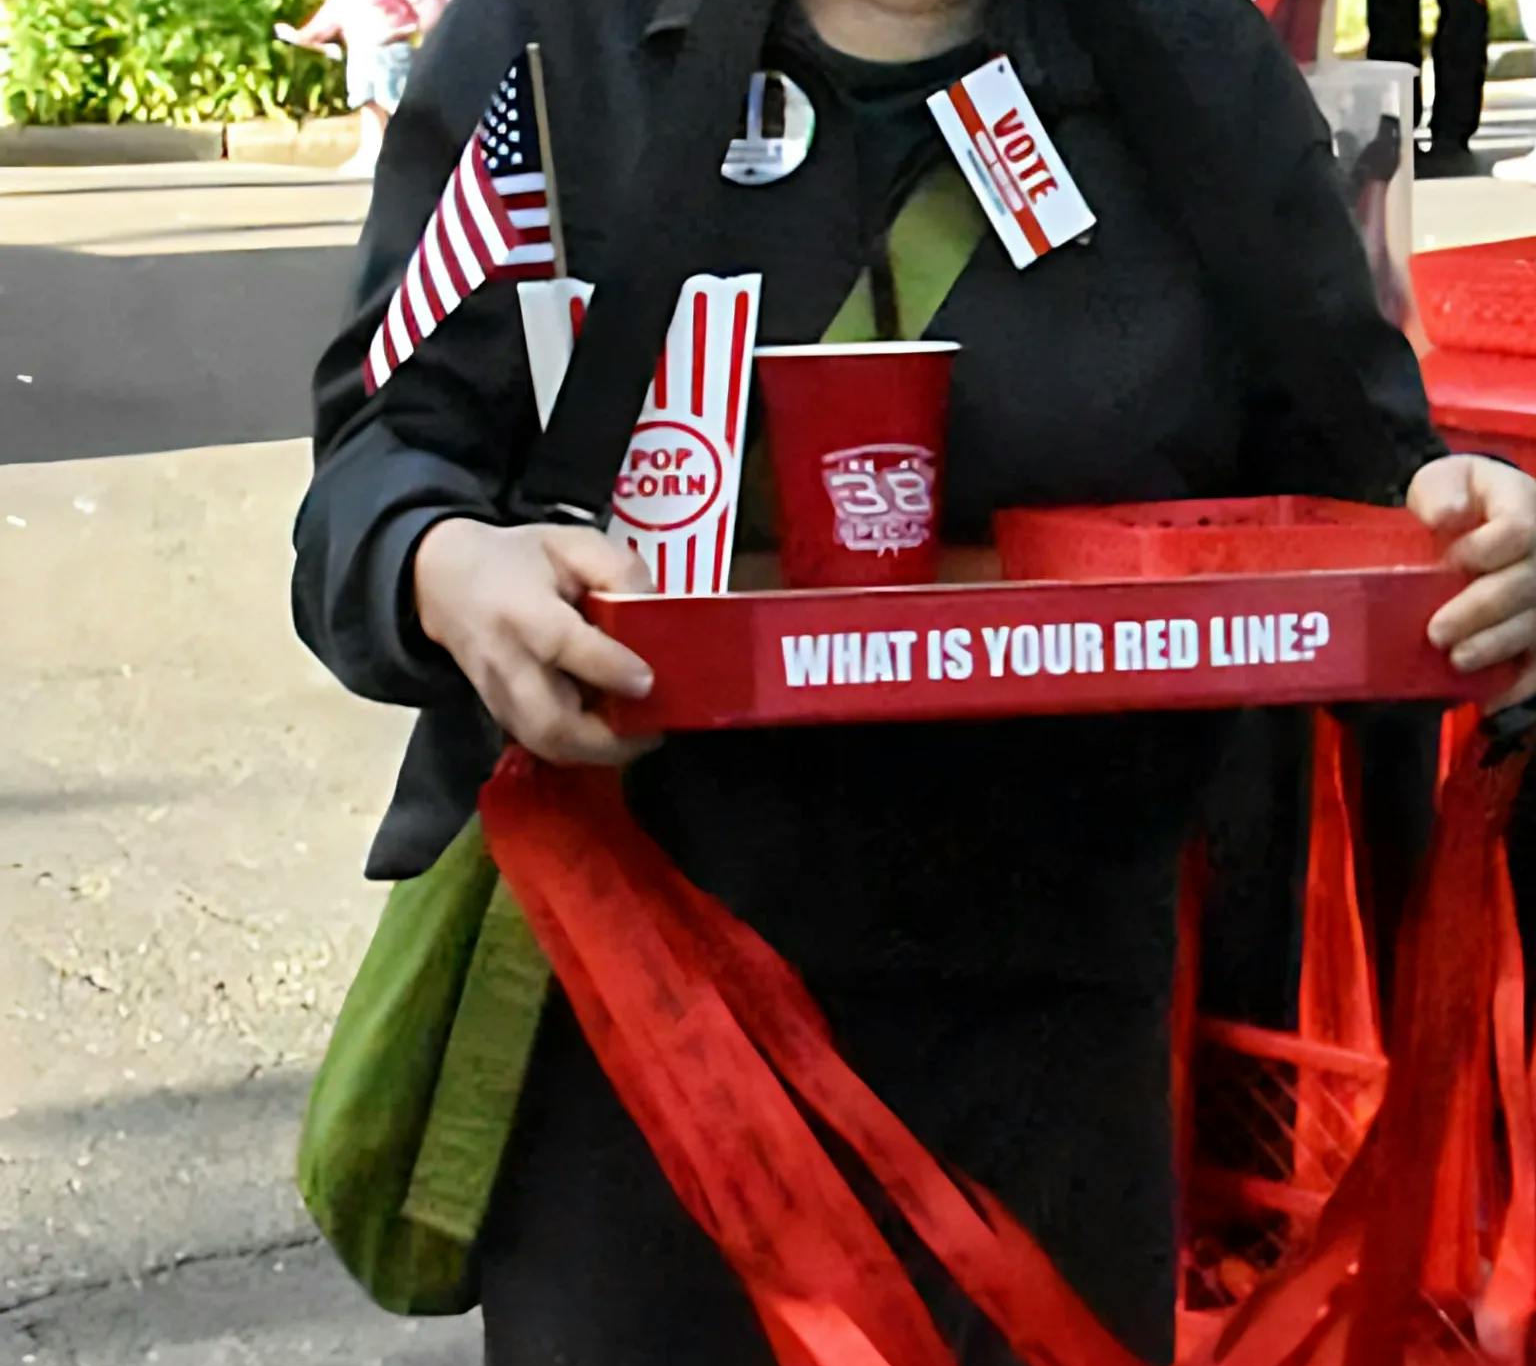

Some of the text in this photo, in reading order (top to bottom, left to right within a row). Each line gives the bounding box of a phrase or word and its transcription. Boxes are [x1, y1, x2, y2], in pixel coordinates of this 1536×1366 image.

[992, 107, 1059, 206] VOTE
[630, 447, 693, 471] POP
[614, 474, 706, 499] CORN
[782, 611, 1331, 686] WHAT IS YOUR RED LINE?
